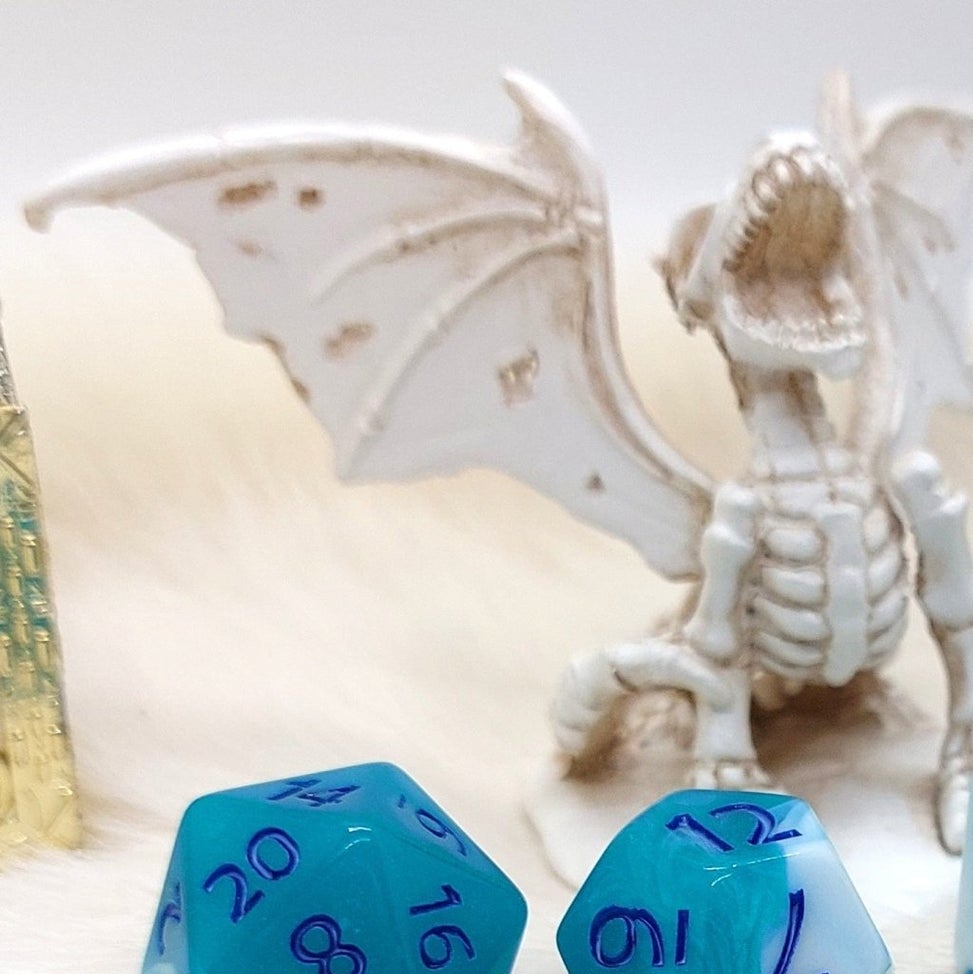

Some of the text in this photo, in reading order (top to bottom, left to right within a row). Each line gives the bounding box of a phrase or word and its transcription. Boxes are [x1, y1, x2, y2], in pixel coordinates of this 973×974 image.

[665, 803, 803, 852] 12
[202, 826, 300, 924] 20
[408, 883, 476, 971] 16
